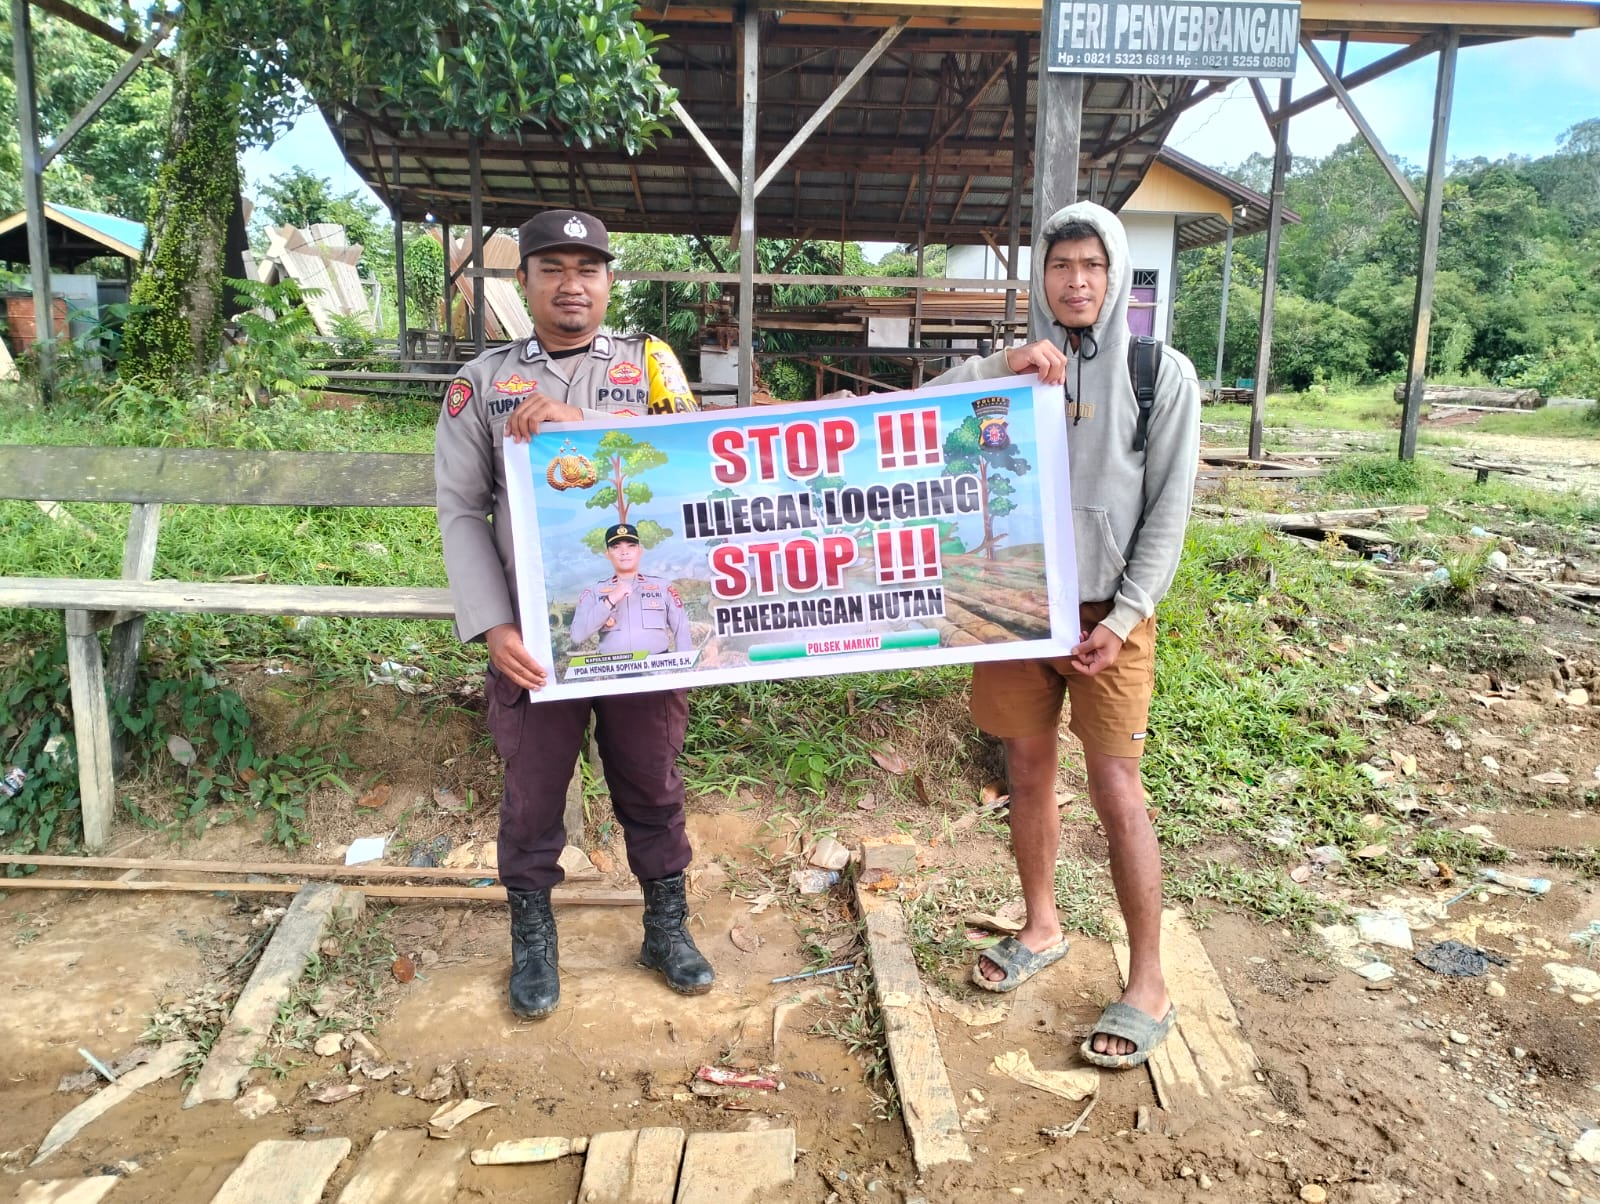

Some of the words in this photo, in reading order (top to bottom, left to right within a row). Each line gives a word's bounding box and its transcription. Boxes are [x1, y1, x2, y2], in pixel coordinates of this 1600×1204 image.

[1058, 2, 1109, 49] FERI
[1114, 4, 1298, 54] PENYEBRANGAN
[1084, 53, 1111, 64] 0821
[1115, 53, 1142, 65] 5323
[1146, 54, 1173, 65] 6811
[1201, 55, 1228, 66] 0821
[1232, 56, 1260, 67] 5255
[1263, 56, 1291, 67] 0880
[598, 387, 649, 404] POLRI
[711, 419, 856, 484] STOP
[878, 410, 941, 468] !!!
[682, 494, 818, 538] ILLEGAL
[825, 476, 980, 526] LOGGING
[711, 536, 856, 597] STOP
[878, 527, 939, 582] !!!
[717, 599, 865, 635] PENEBANGAN
[869, 588, 943, 621] HUTAN
[807, 640, 841, 654] POLSEK
[843, 637, 880, 652] MARIKIT
[574, 668, 588, 676] IPDA
[589, 665, 615, 674] HENDRA
[616, 663, 642, 672] SOPIYAN
